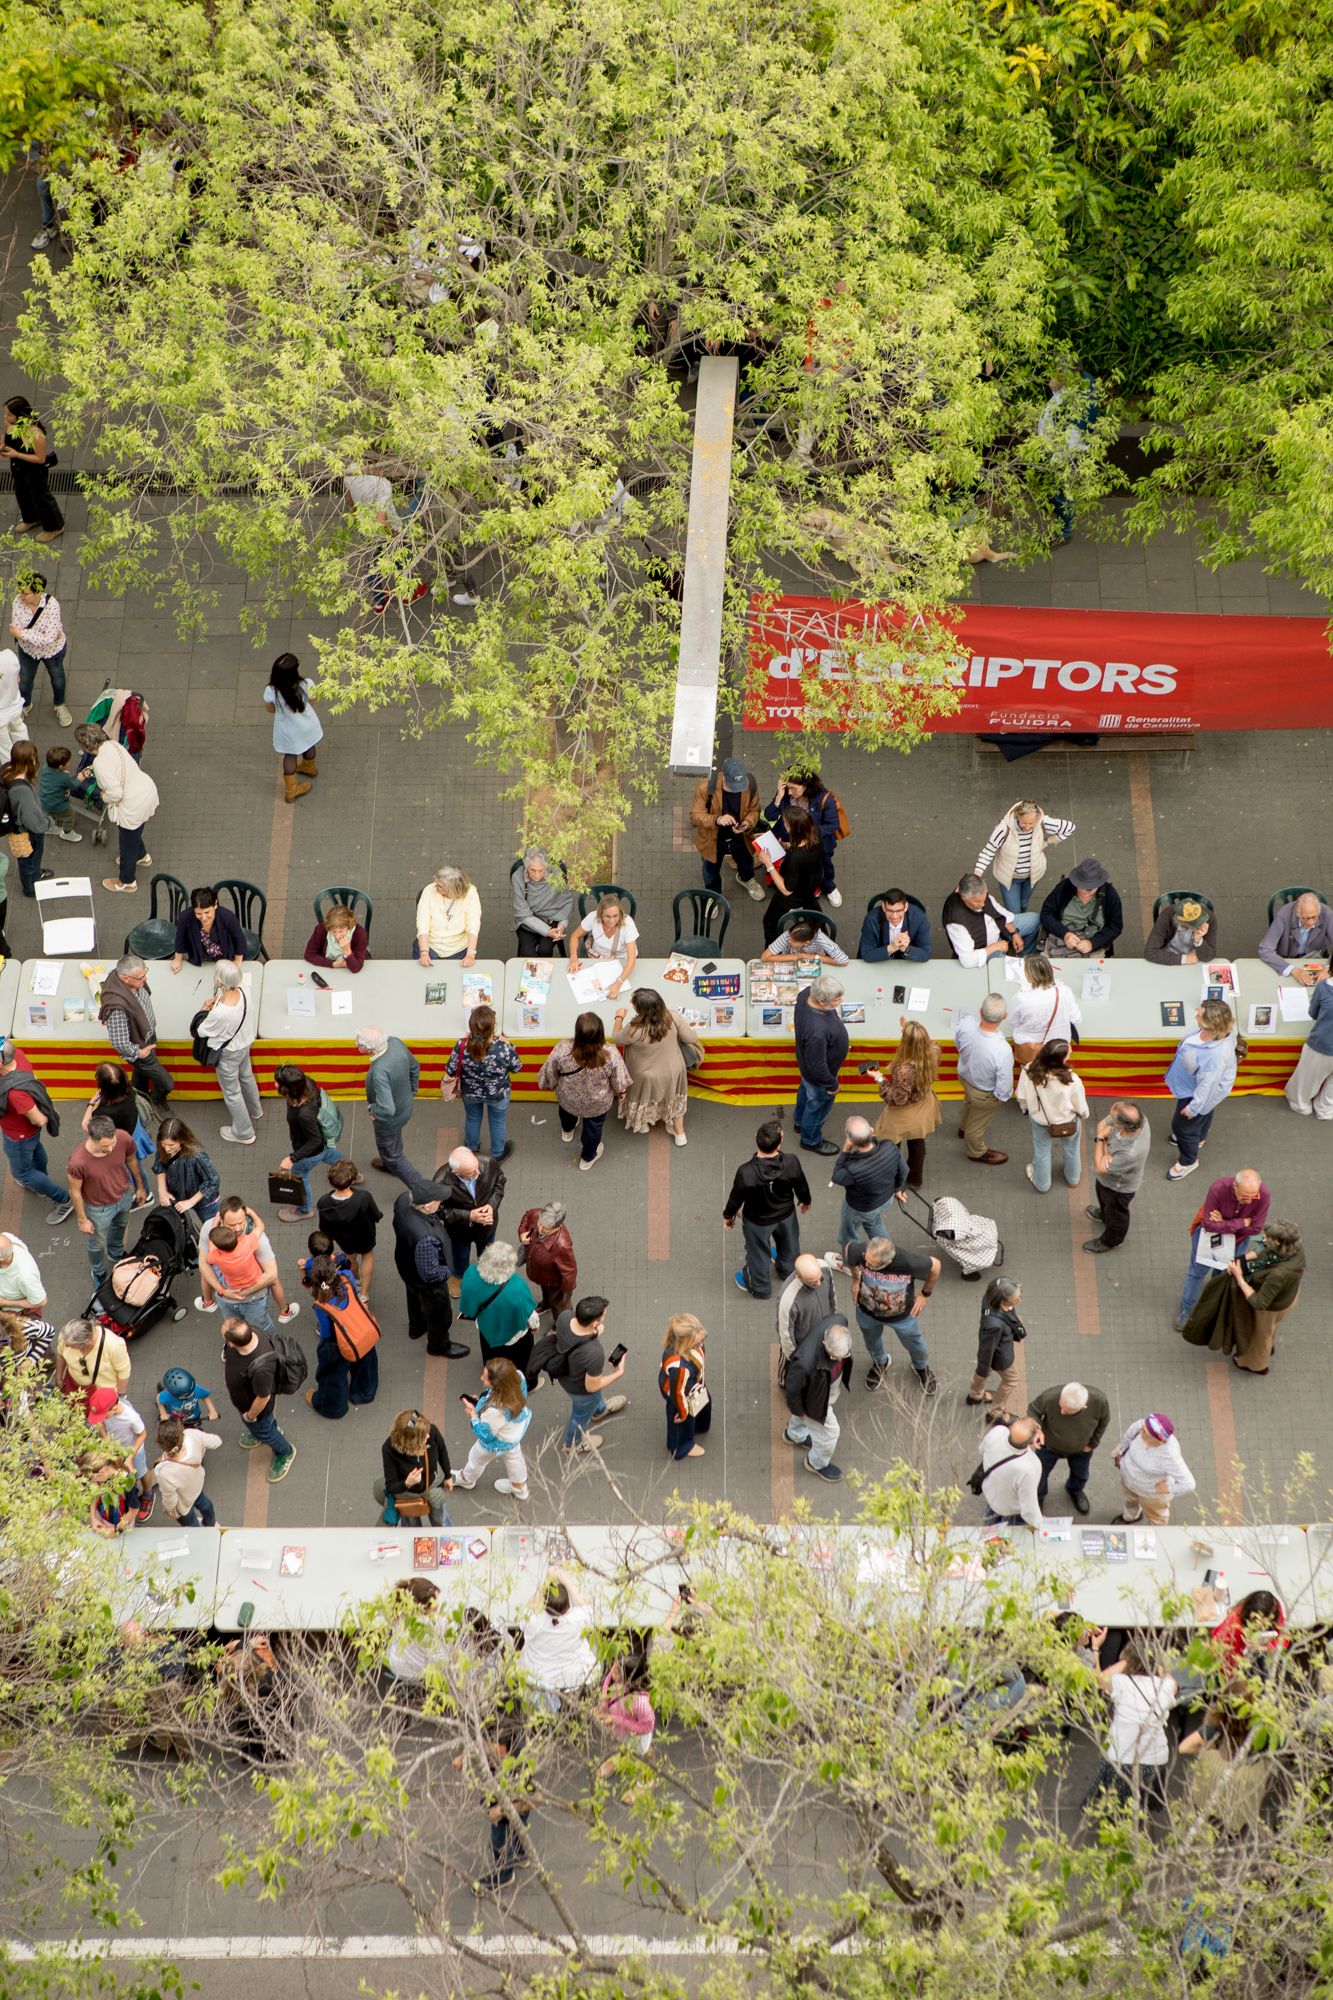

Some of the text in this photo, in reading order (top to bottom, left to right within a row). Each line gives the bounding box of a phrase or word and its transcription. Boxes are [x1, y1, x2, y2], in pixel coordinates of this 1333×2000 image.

[990, 711, 1060, 720] Fundació
[1126, 715, 1191, 724] Generalitat
[989, 718, 1072, 727] FLUIDRA
